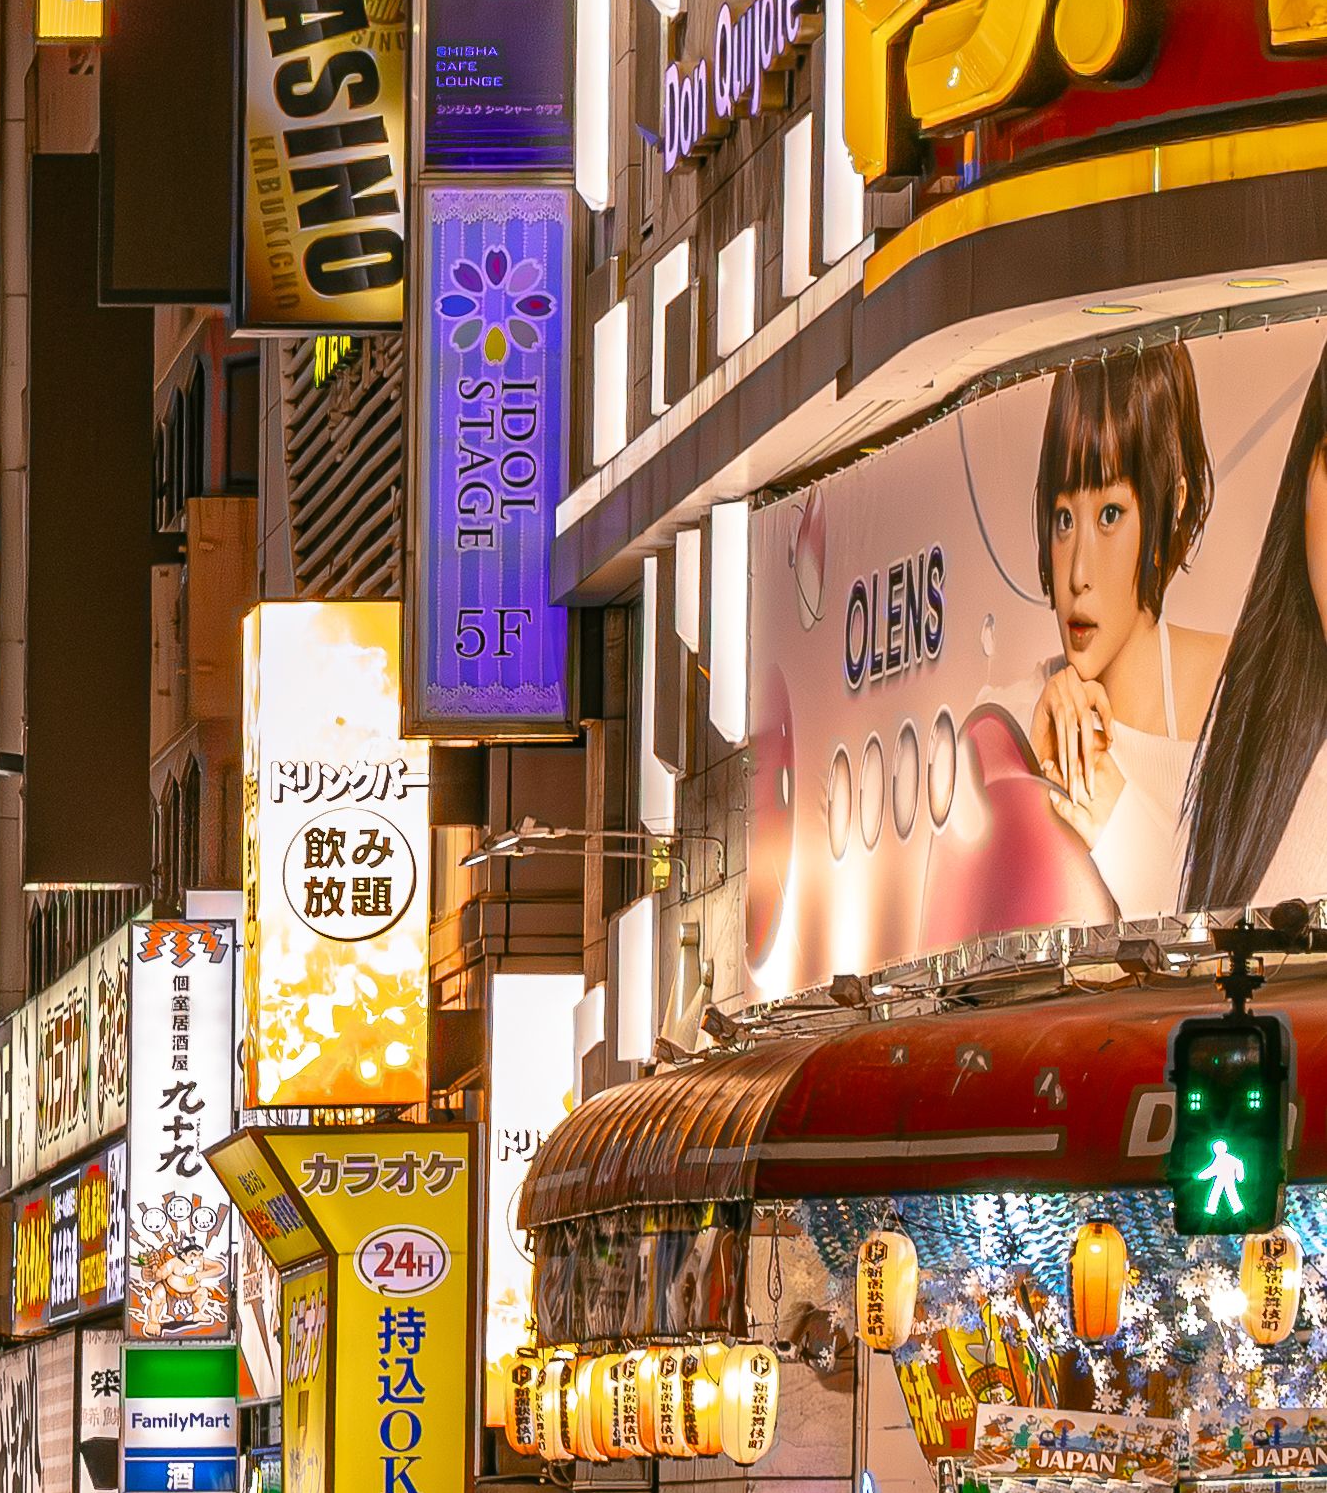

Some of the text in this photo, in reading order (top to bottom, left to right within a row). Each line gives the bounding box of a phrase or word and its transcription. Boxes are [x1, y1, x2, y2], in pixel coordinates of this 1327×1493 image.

[436, 46, 499, 57] SHISHA
[436, 61, 478, 72] CAFE
[435, 76, 504, 88] LOUNGE
[663, 45, 708, 171] Don
[454, 378, 495, 550] STAGE
[497, 378, 539, 522] IDOL
[454, 605, 534, 660] 5F
[844, 543, 948, 692] OLENS
[270, 761, 429, 804] ドリンクバー
[303, 826, 394, 869] 飲み
[303, 876, 394, 919] 放題
[173, 974, 189, 1072] 個室居酒屋
[157, 1080, 204, 1176] 九十九
[300, 1153, 464, 1196] カラオケ
[374, 1239, 436, 1281] 24H
[132, 1412, 231, 1432] FamilyMart
[166, 1462, 195, 1490] 酒
[1035, 1448, 1118, 1474] JAPAN
